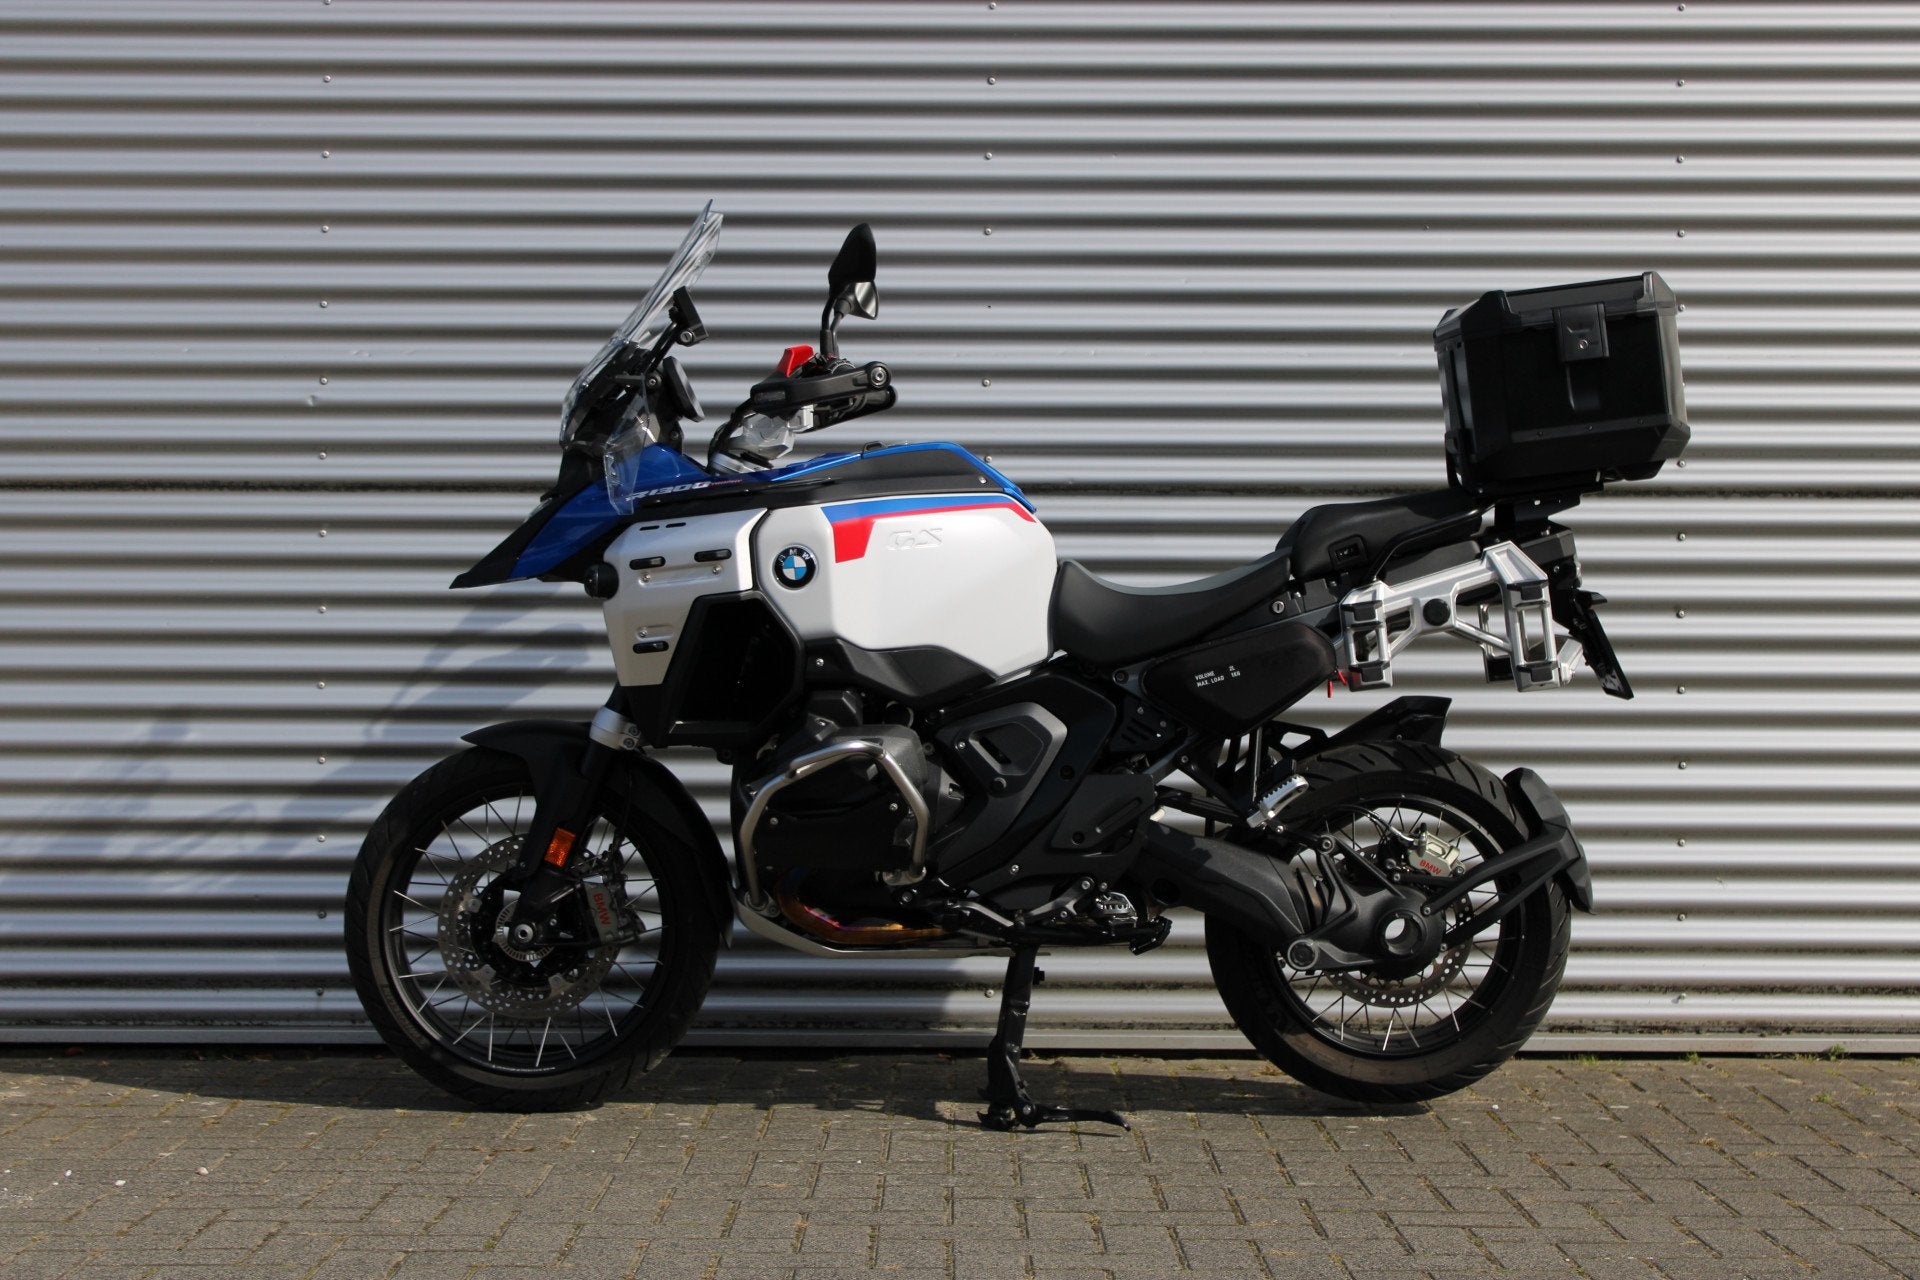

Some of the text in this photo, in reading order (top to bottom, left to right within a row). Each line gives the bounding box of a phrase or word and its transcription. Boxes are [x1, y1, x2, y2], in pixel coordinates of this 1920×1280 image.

[887, 527, 943, 550] GS
[778, 548, 812, 567] BMW
[1194, 671, 1215, 681] VOLUME
[1210, 675, 1225, 684] LOAD
[1419, 859, 1441, 875] BMW
[592, 892, 612, 925] BMW
